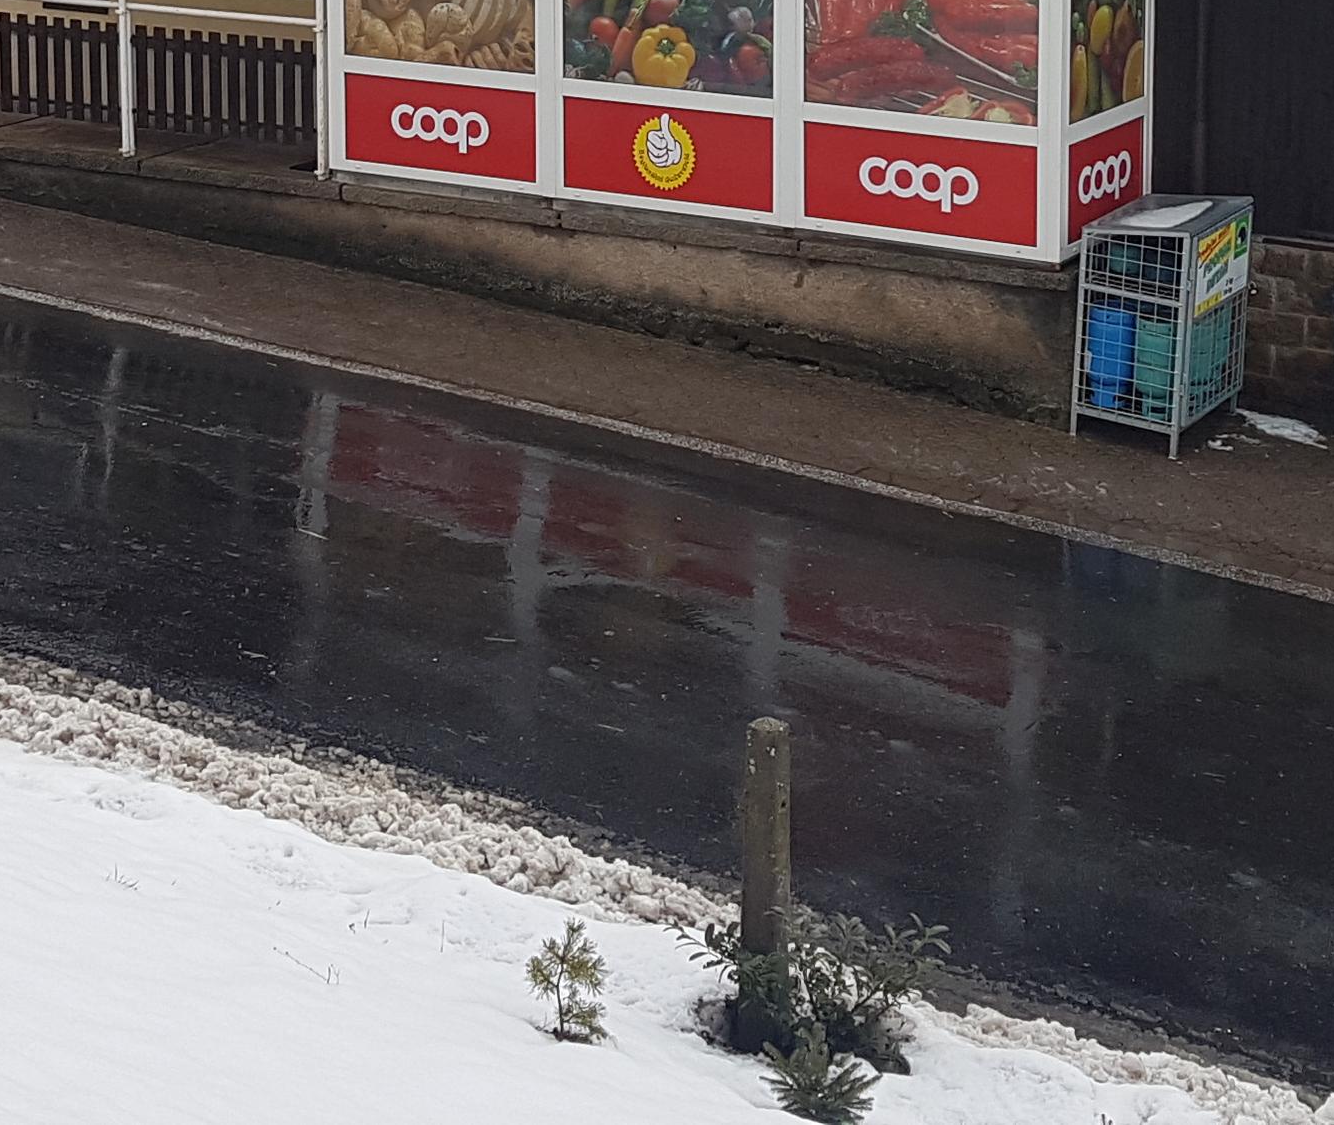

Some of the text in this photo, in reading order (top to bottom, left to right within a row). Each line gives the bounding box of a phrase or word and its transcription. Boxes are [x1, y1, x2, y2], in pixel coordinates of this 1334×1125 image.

[390, 103, 490, 154] coop
[858, 156, 979, 213] coop
[1078, 150, 1131, 204] coop
